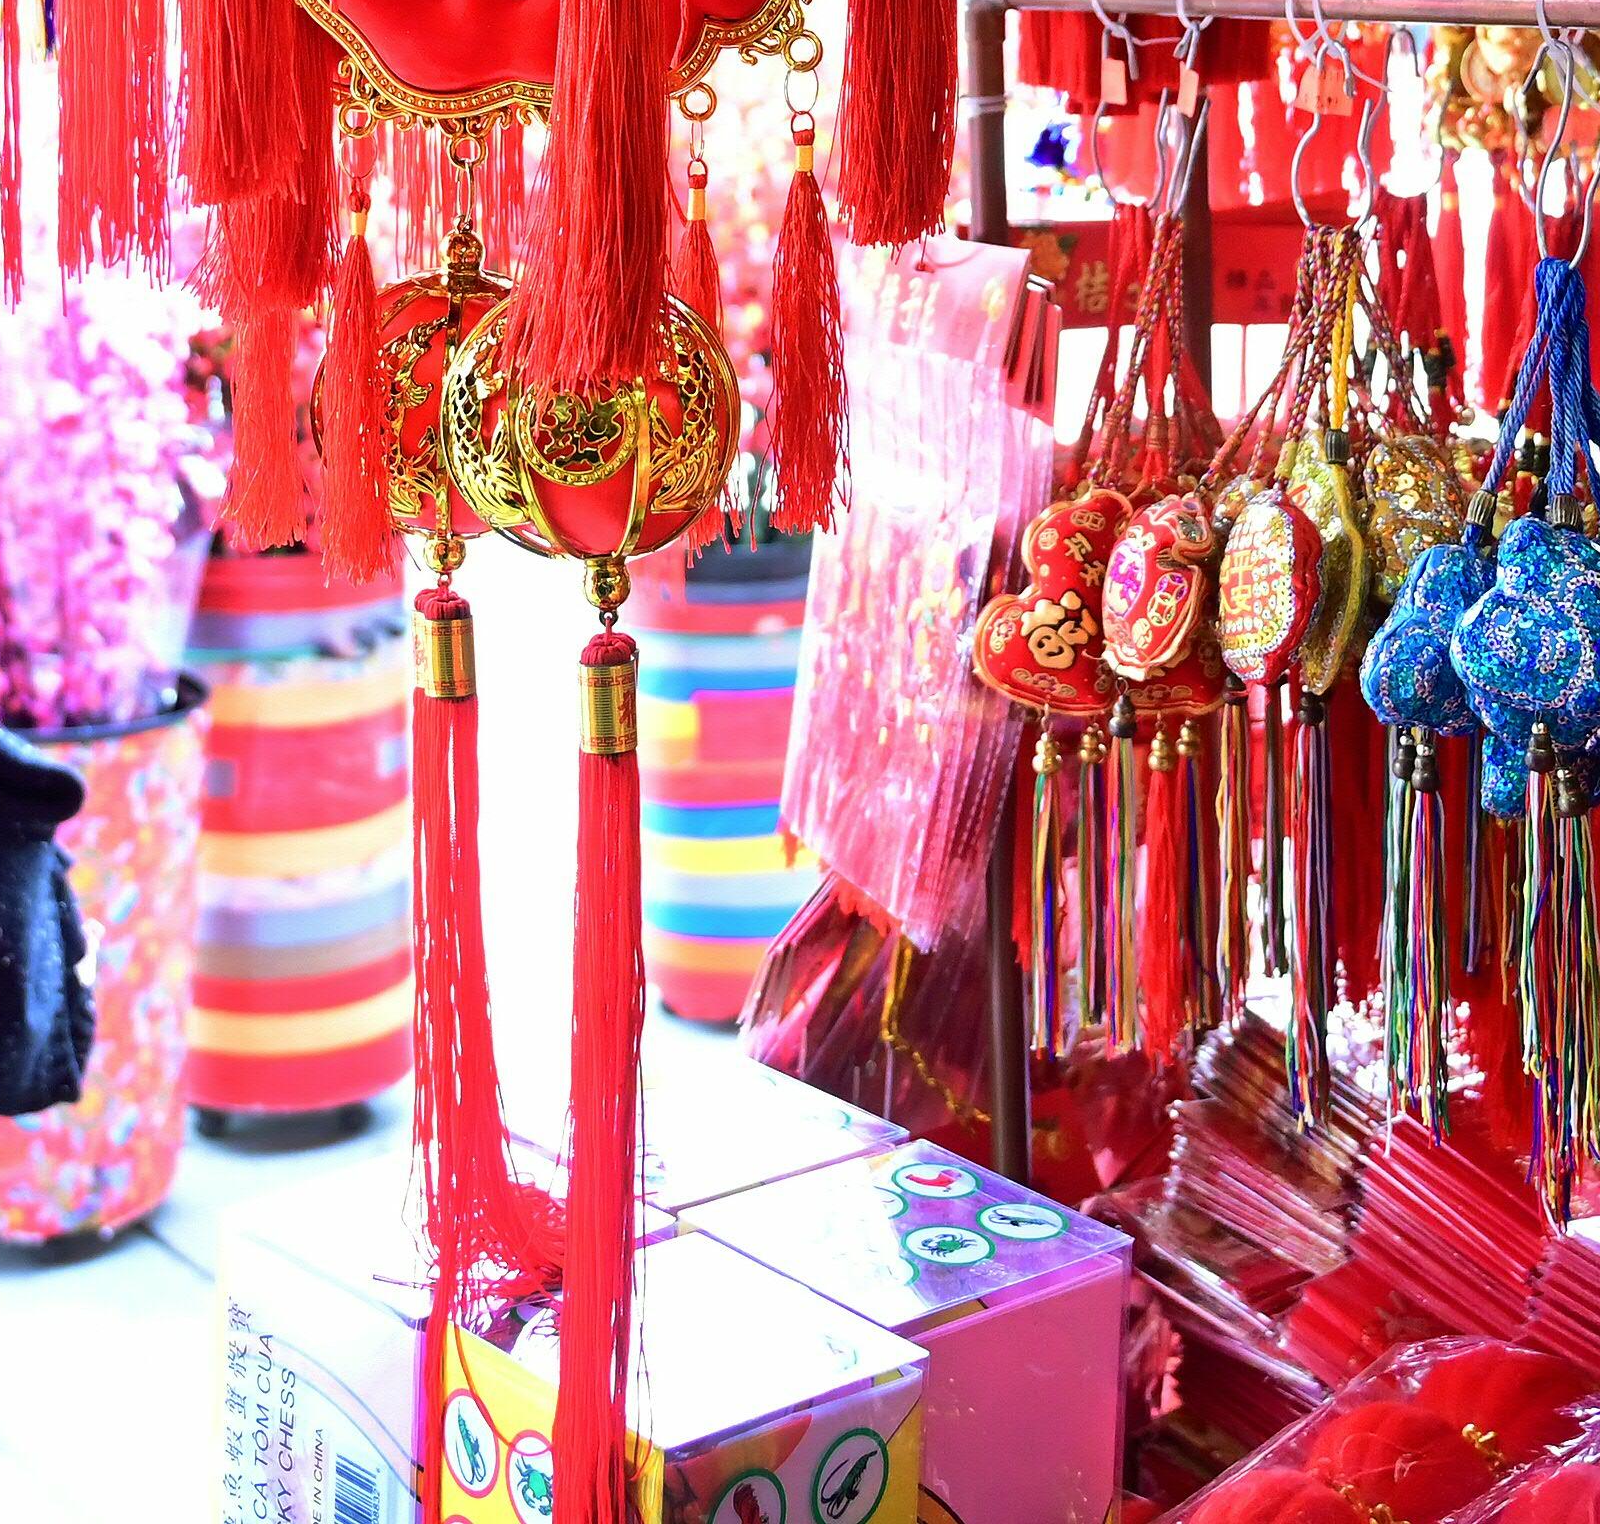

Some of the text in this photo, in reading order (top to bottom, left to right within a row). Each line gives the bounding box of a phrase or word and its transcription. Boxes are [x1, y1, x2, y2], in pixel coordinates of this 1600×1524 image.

[257, 1333, 274, 1395] CUA
[252, 1403, 271, 1467] TÔM
[276, 1367, 297, 1524] KY CHESS
[312, 1428, 324, 1482] CHINA
[312, 1486, 322, 1505] IN
